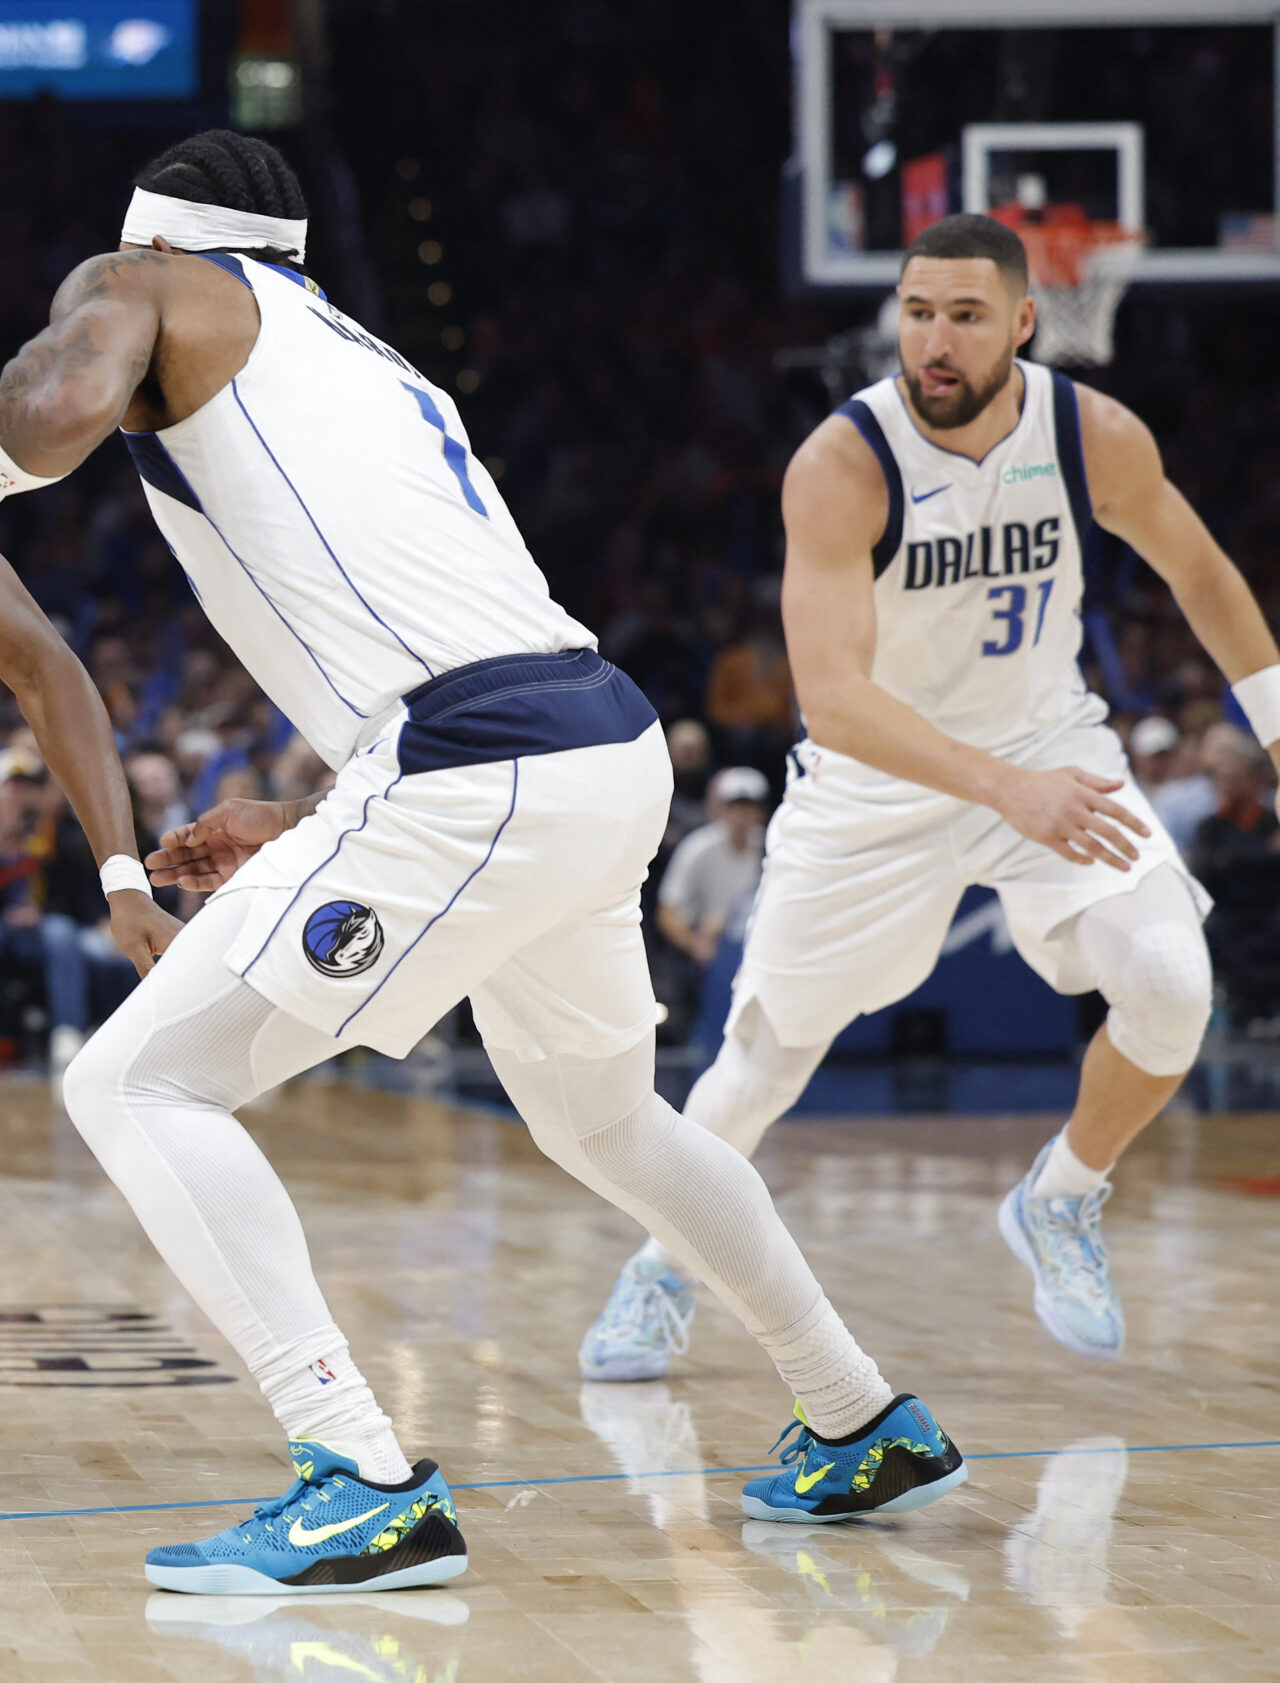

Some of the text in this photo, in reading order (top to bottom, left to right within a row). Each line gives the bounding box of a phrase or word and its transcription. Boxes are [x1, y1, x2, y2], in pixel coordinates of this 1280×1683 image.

[1003, 462, 1056, 484] chime
[904, 516, 1061, 591] DALLAS
[981, 577, 1054, 657] 31
